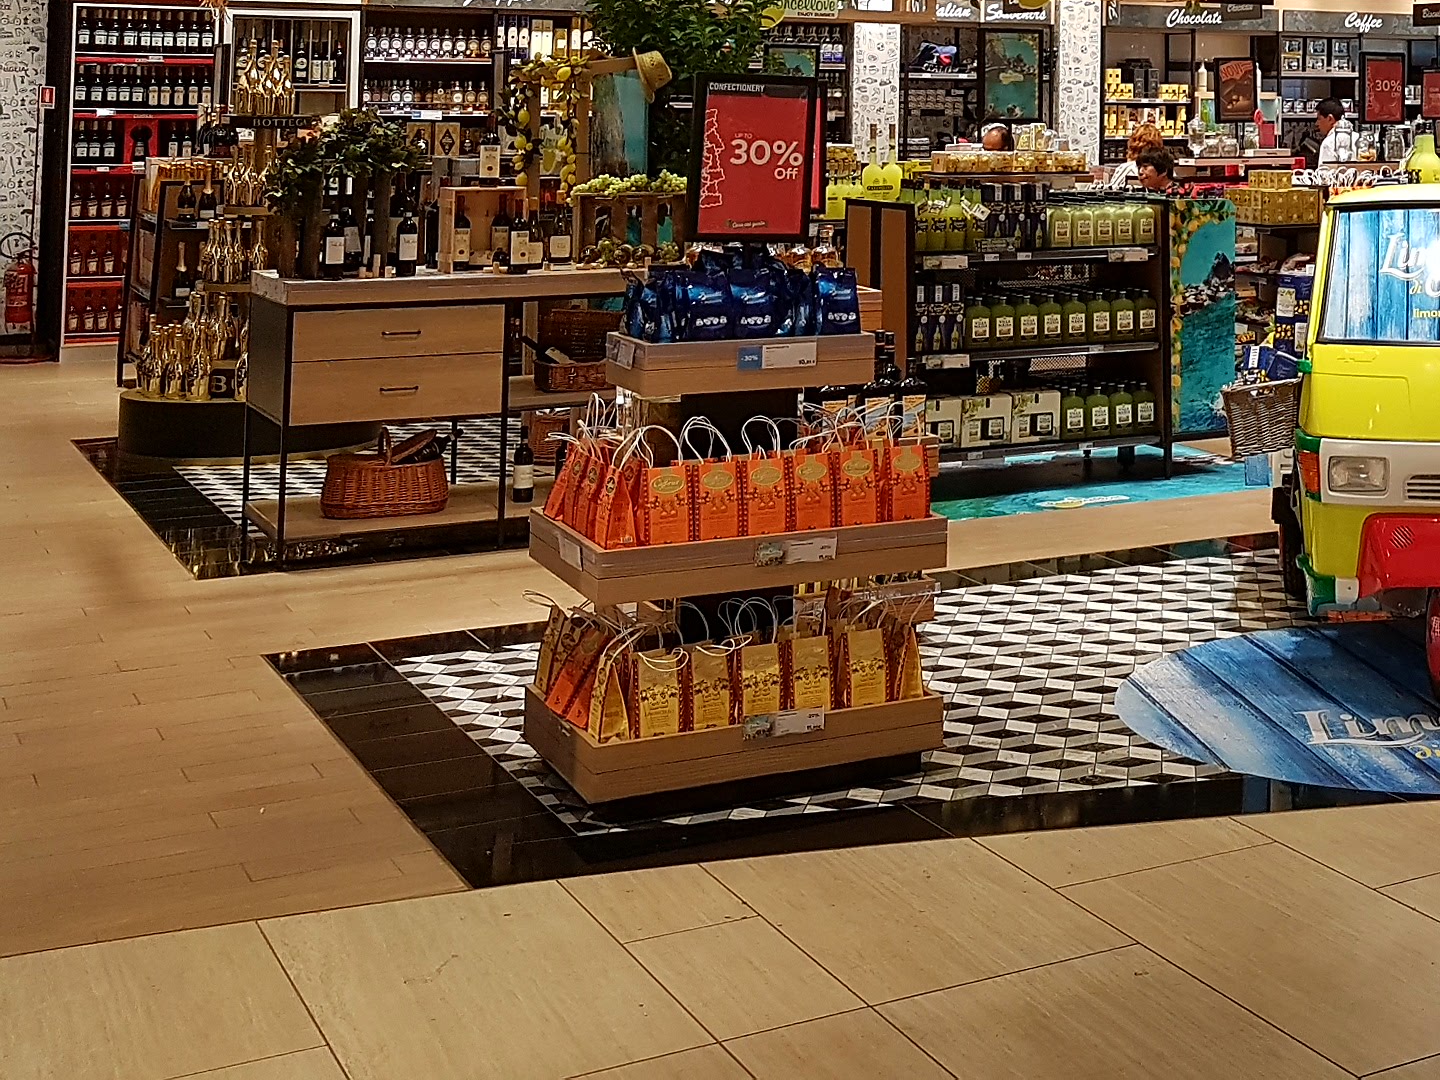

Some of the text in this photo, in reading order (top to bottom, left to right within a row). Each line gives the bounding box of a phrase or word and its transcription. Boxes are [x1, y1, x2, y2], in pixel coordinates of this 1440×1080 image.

[935, 1, 971, 18] alian
[1166, 8, 1222, 28] Chocolate
[1344, 12, 1383, 34] Coffee
[708, 82, 766, 93] CONFECTIONERY
[1375, 79, 1402, 92] 30%
[253, 118, 310, 127] BOTTEG
[730, 138, 804, 167] 30%
[773, 167, 799, 180] Off
